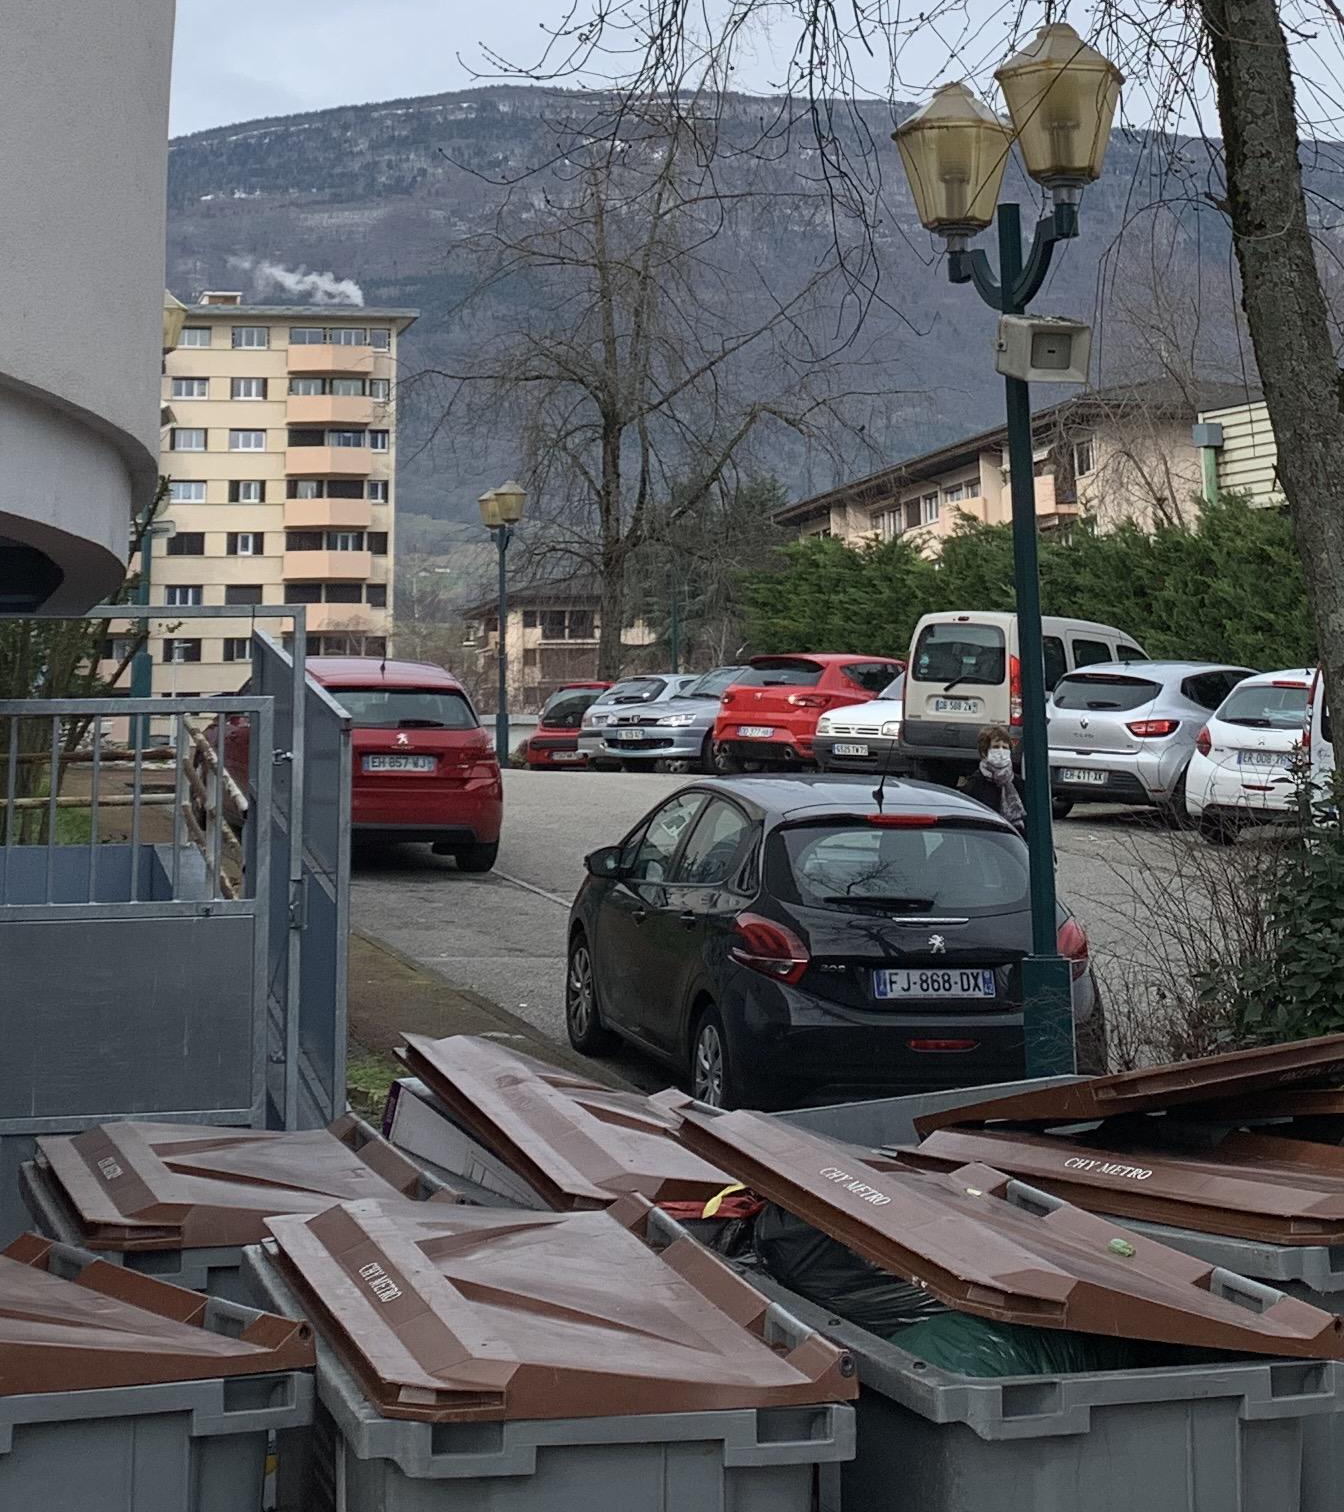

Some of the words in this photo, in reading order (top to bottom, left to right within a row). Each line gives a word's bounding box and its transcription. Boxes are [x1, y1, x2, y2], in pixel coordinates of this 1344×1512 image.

[888, 971, 982, 993] FJ-868-DX
[1064, 1157, 1101, 1171] CHY
[1096, 1163, 1153, 1180] METRO
[819, 1167, 854, 1183] CHY
[842, 1180, 892, 1206] METRO
[368, 1274, 403, 1303] METRO
